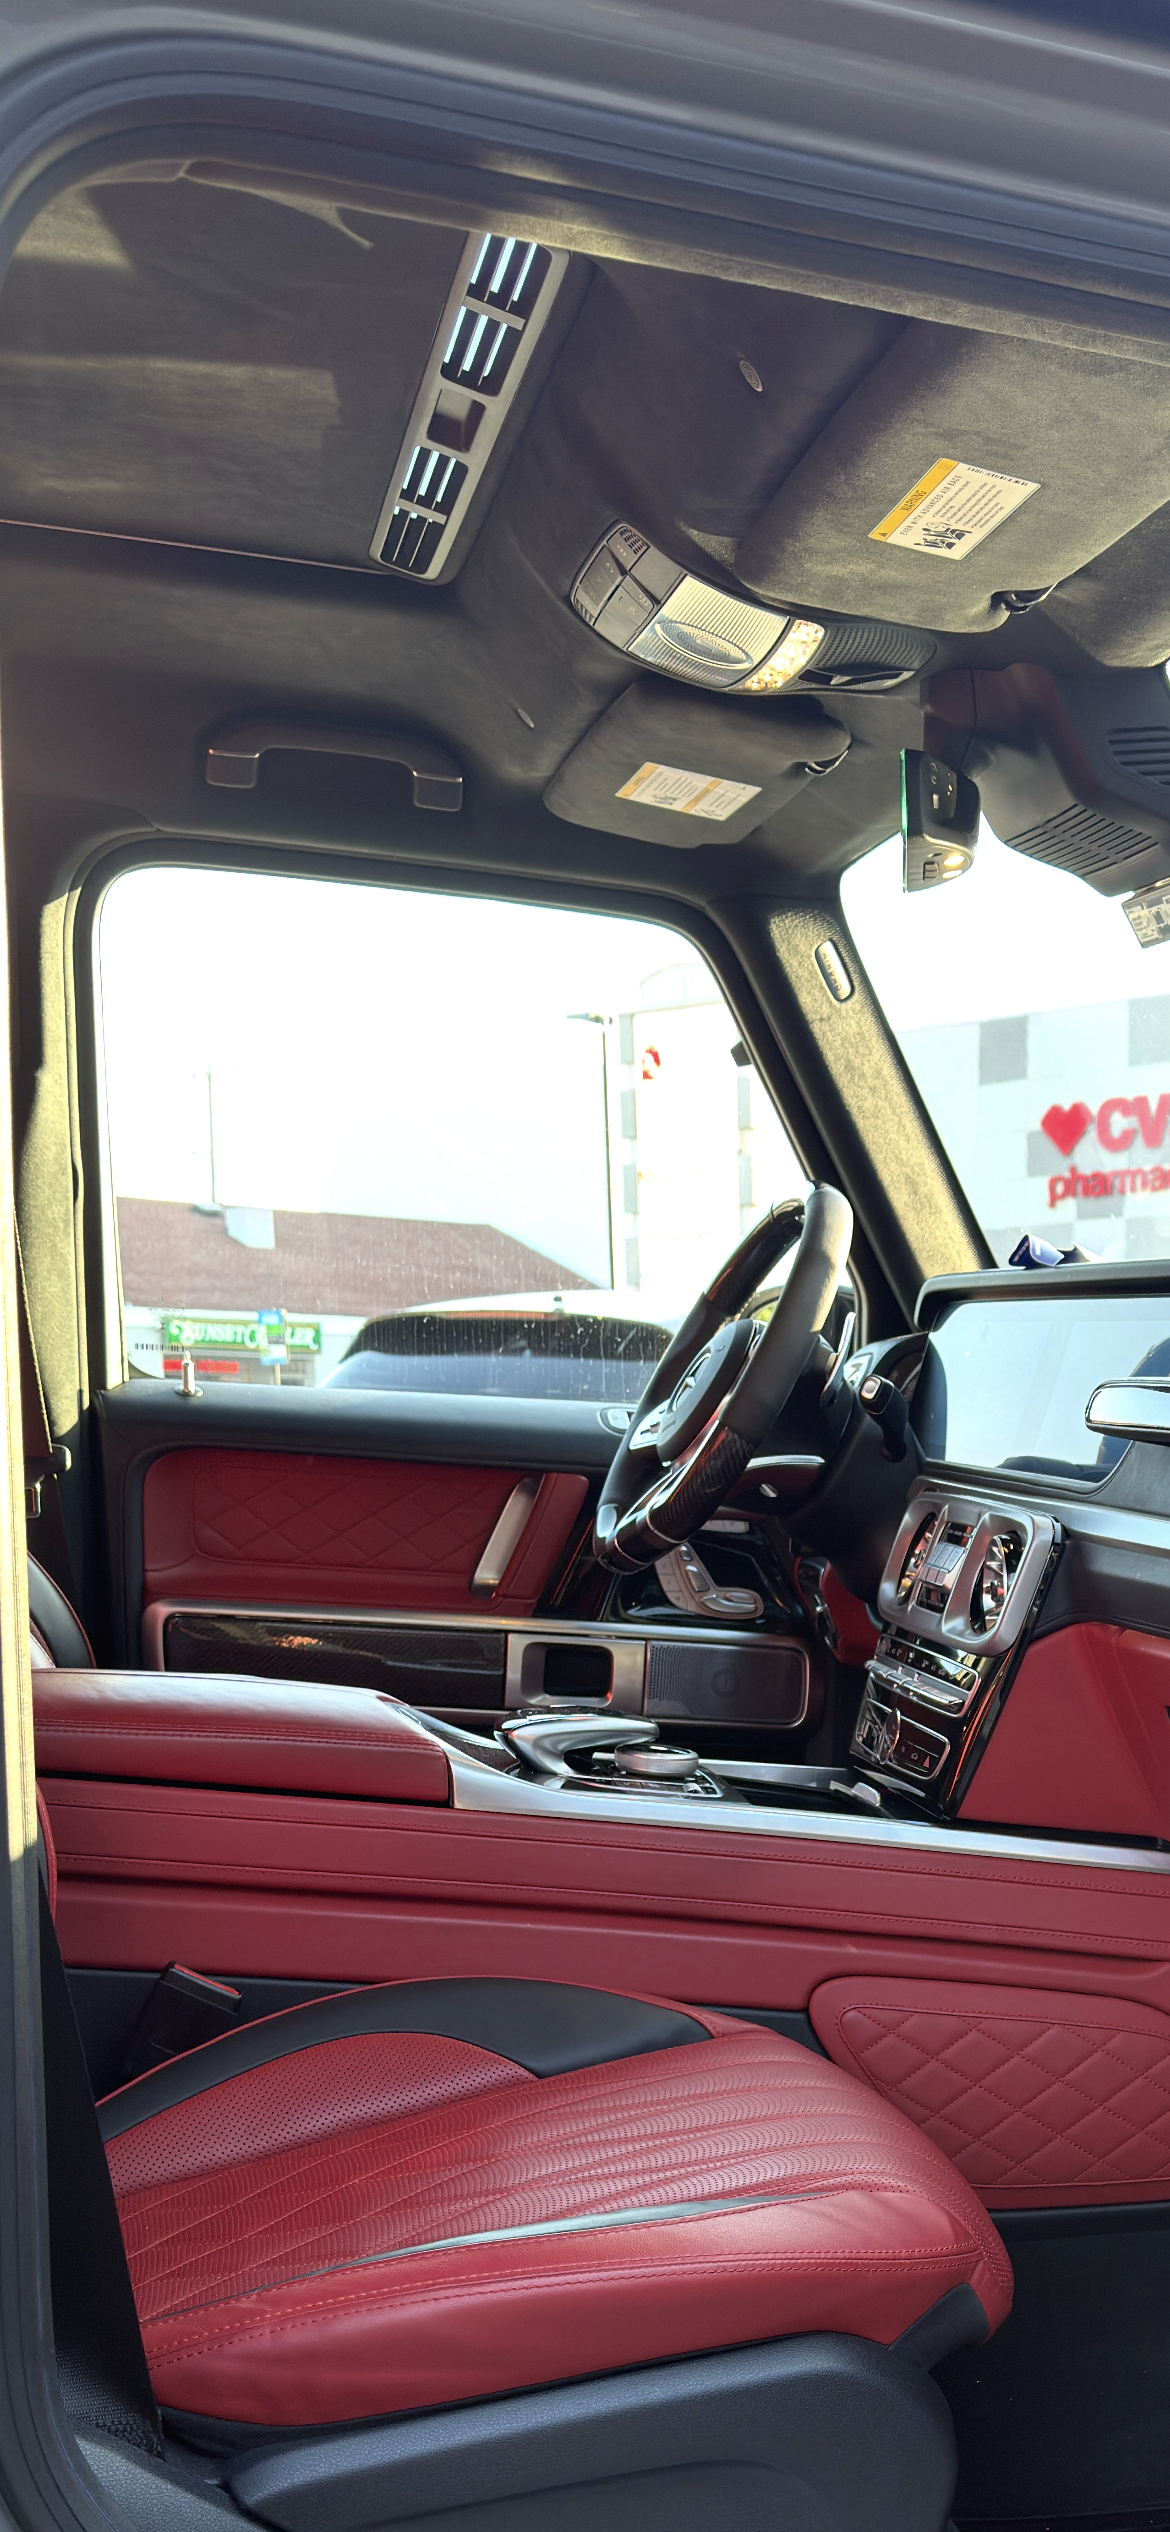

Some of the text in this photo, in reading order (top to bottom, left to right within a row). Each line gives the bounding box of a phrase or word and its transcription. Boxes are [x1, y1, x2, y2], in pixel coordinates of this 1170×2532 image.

[900, 490, 927, 511] WARNING
[900, 525, 913, 535] EVEN
[911, 514, 924, 525] WITH
[921, 494, 944, 515] ADVANCED
[1096, 1093, 1170, 1152] CV
[1048, 1166, 1170, 1208] pharma
